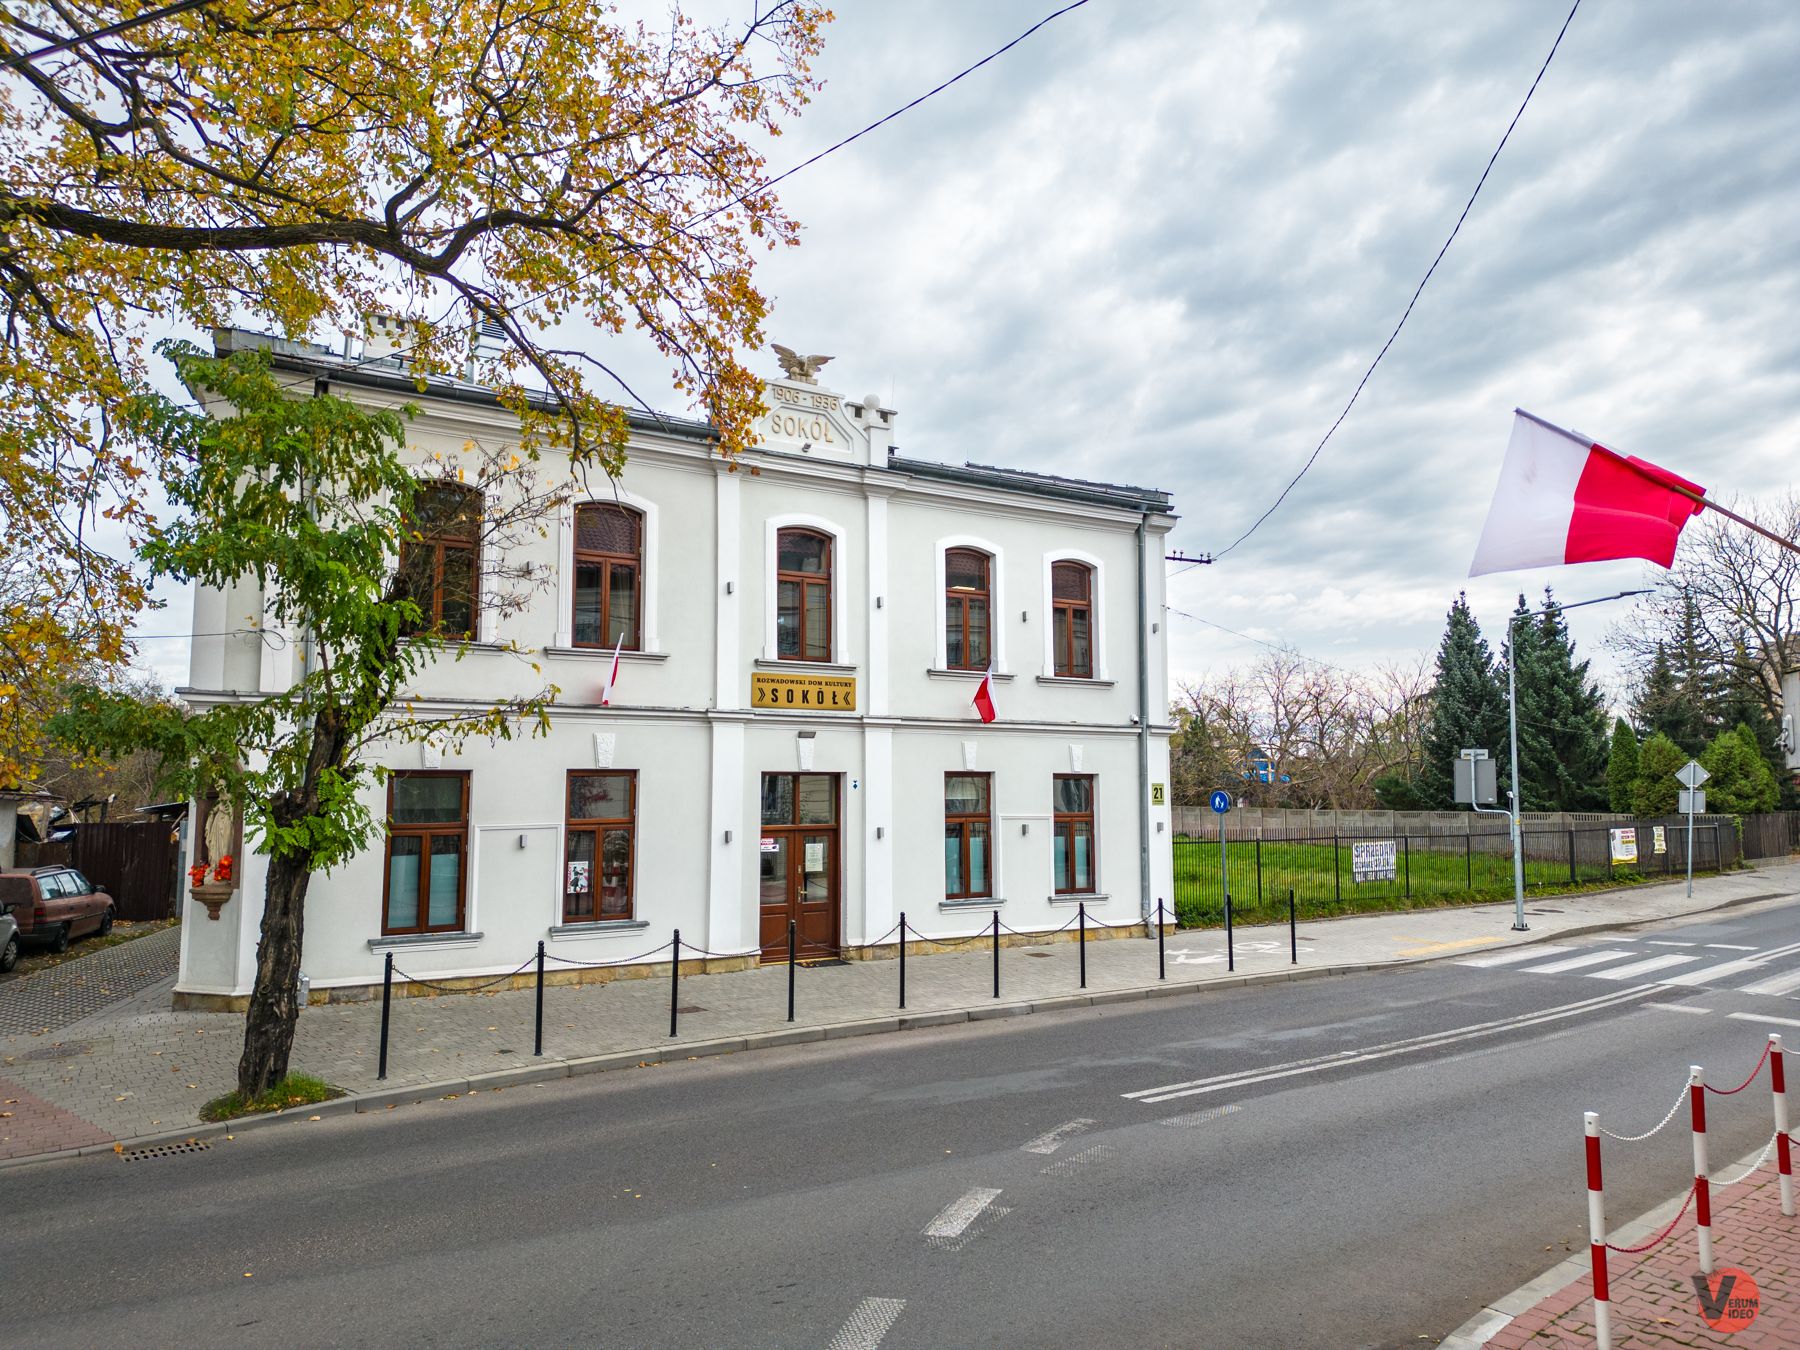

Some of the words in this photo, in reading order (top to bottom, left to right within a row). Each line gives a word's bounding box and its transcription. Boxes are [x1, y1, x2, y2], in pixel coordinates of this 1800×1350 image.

[772, 388, 800, 404] 1906
[810, 395, 838, 410] 1936
[771, 414, 833, 443] SOKÓŁ
[1153, 787, 1163, 799] 21
[1354, 843, 1395, 858] SPRZEDAM
